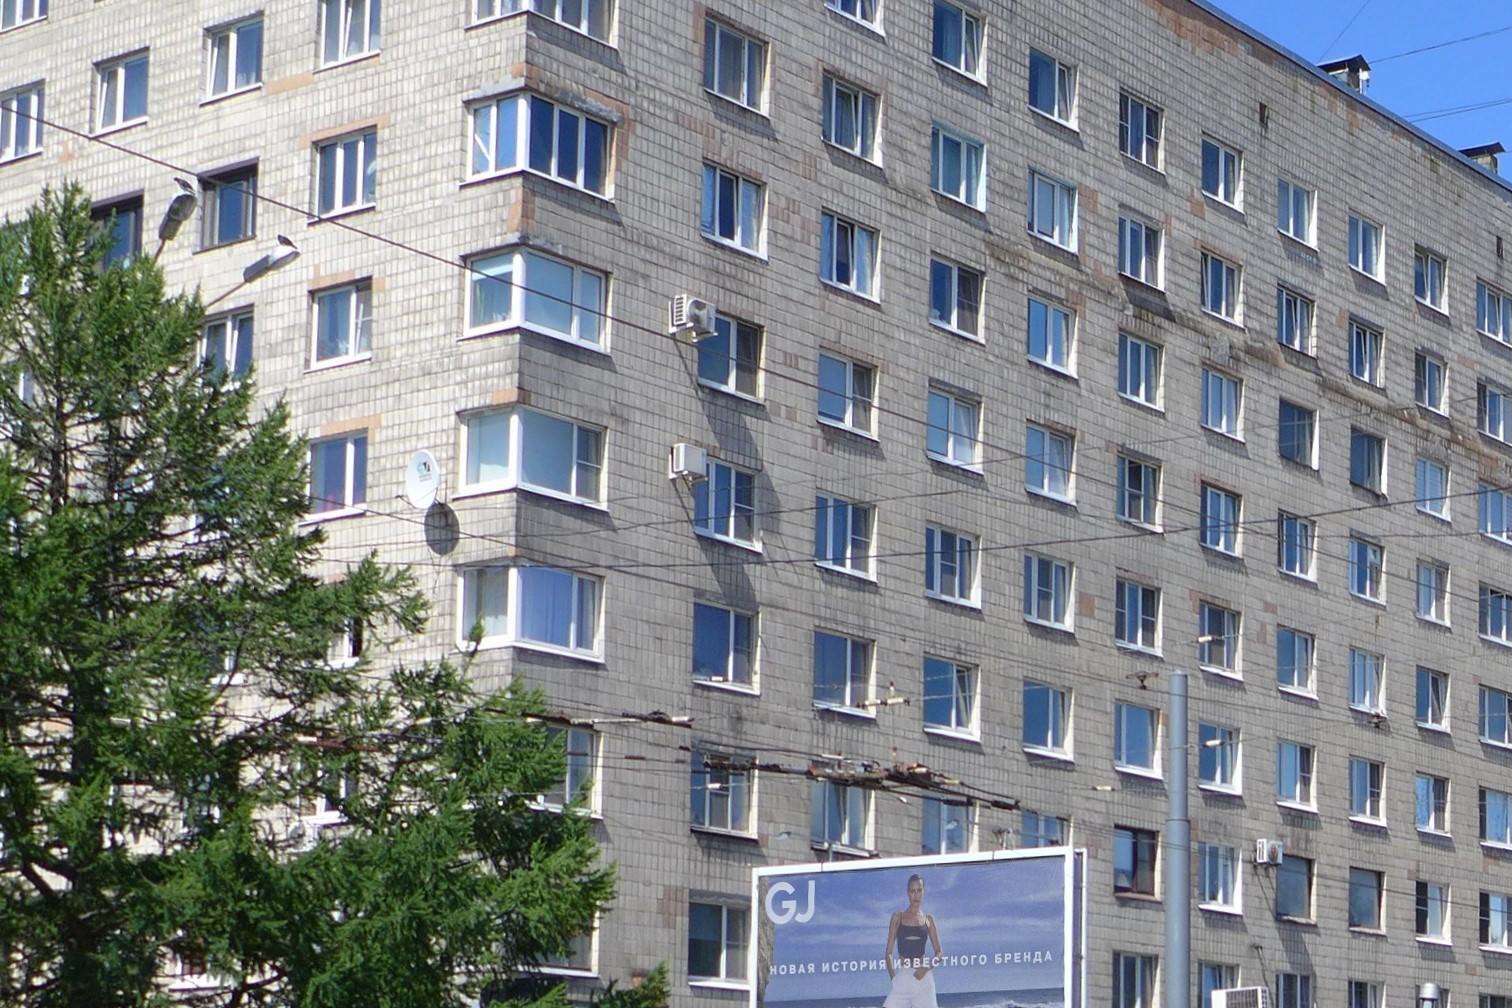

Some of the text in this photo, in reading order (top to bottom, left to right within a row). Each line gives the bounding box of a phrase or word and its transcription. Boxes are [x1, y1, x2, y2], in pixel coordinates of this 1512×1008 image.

[764, 879, 816, 925] GJ
[769, 951, 1053, 976] НОВАЯ ИСТОРИЯ ИЗВЕСТНОГО БРЕНДА
